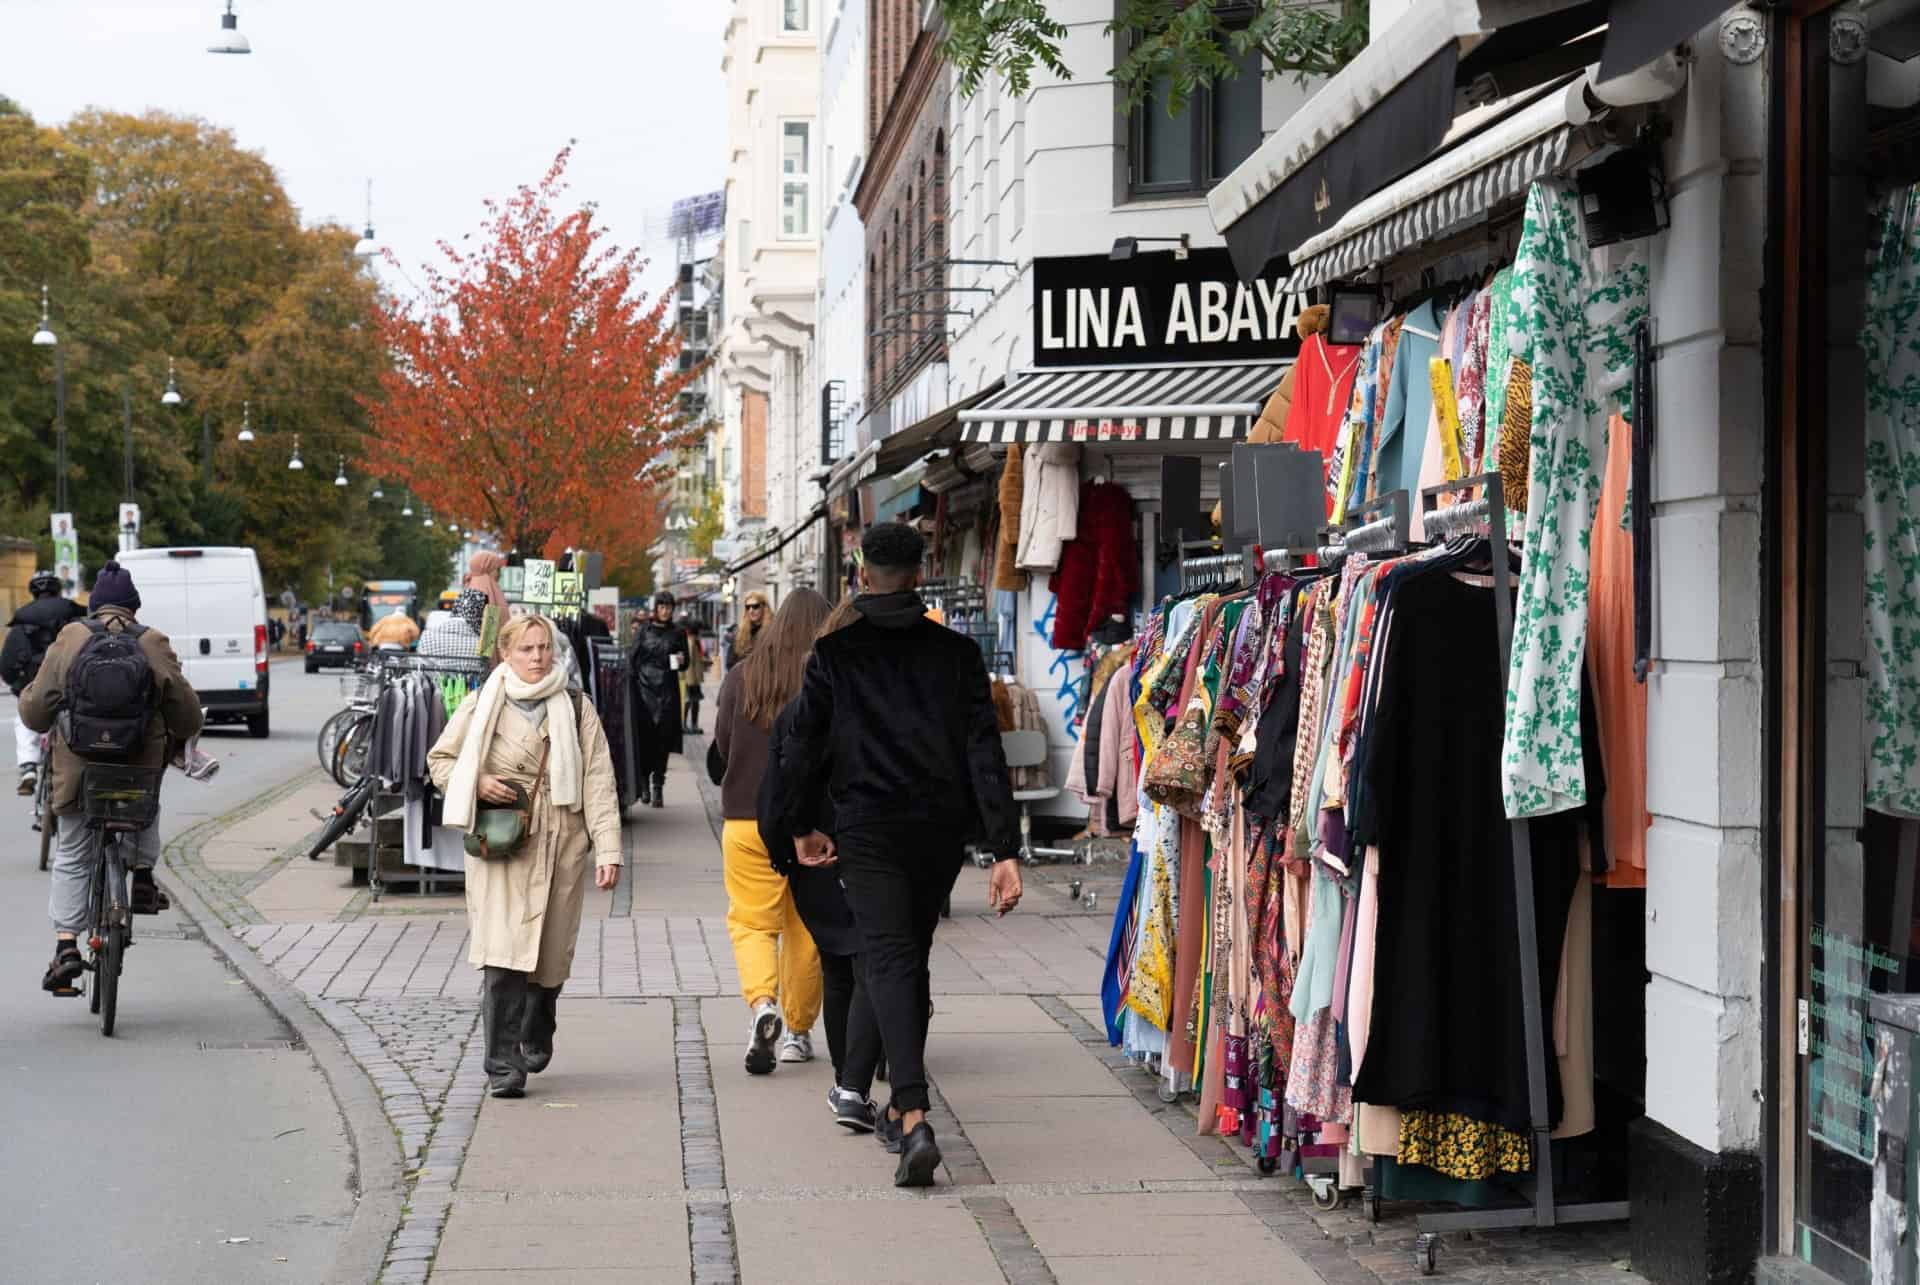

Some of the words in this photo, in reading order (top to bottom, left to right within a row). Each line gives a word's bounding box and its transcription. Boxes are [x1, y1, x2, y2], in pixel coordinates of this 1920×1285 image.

[1042, 286, 1147, 349] LINA
[1164, 276, 1309, 344] ABAYA
[1067, 423, 1097, 437] Lina
[1101, 421, 1143, 437] Abaya
